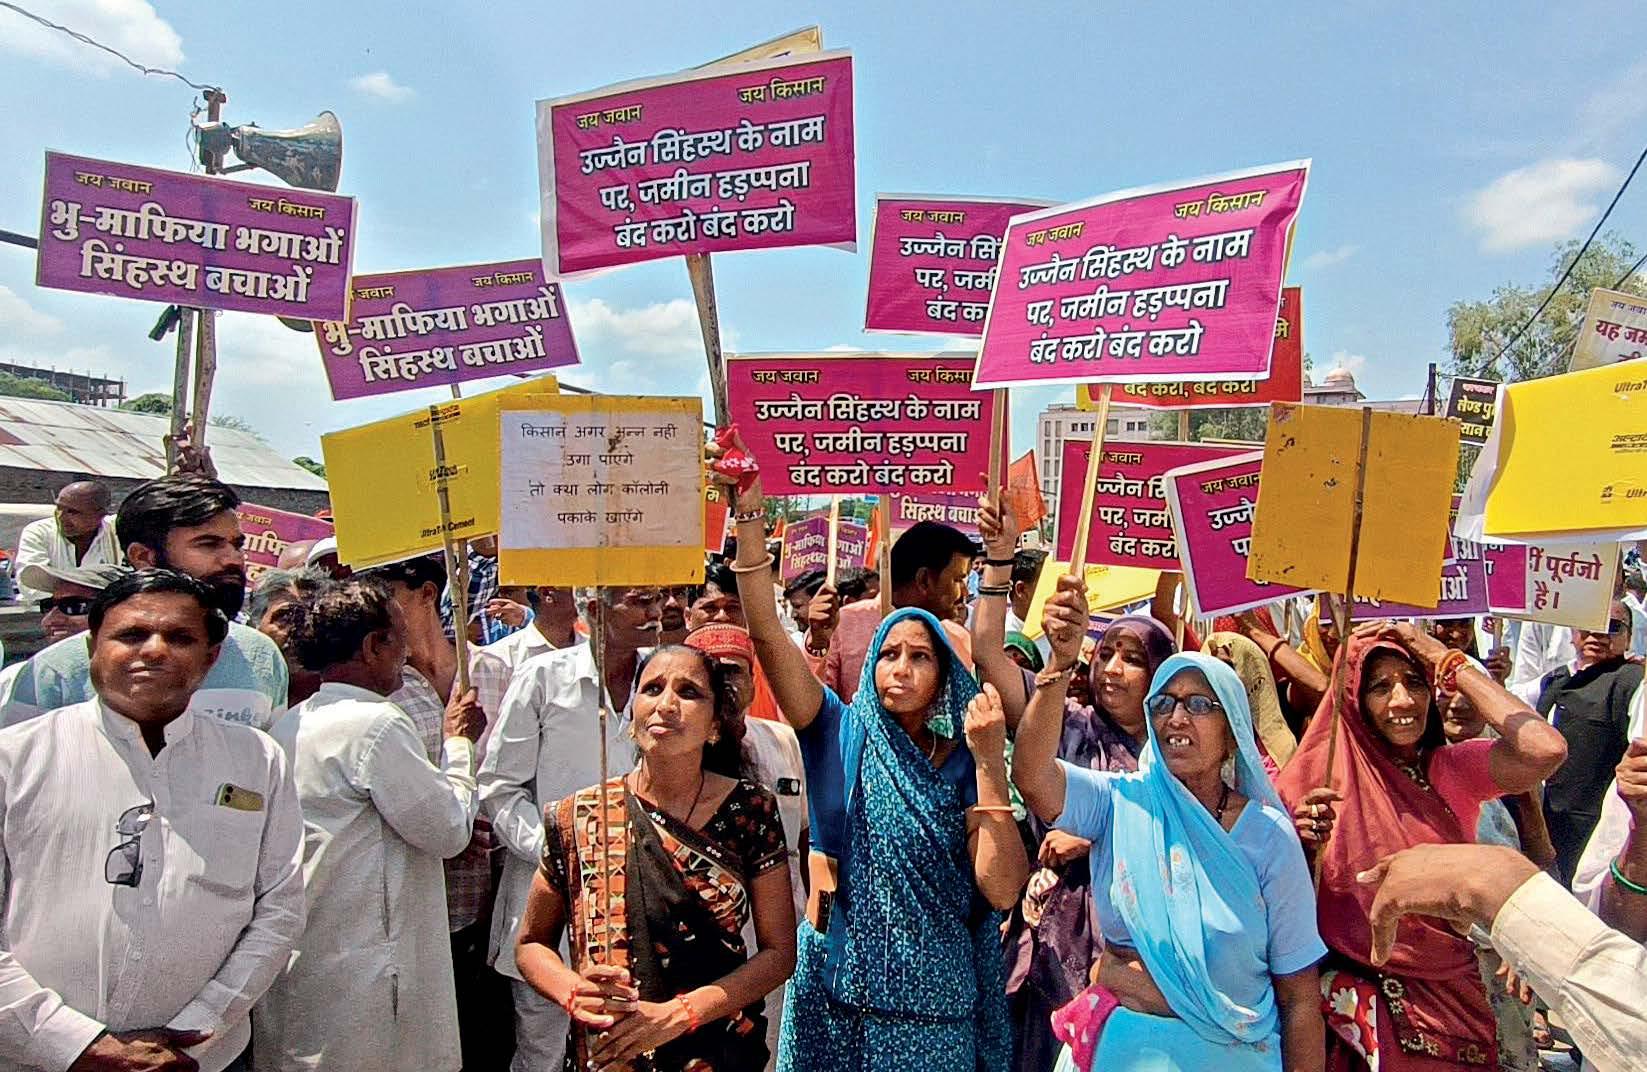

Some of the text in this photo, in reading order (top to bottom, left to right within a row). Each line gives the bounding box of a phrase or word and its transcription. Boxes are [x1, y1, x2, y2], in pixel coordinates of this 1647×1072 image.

[738, 76, 825, 103] जय किसान
[576, 105, 642, 129] जय जवान
[580, 116, 825, 174] उज्जैन सिंहस्थ के नाम
[75, 171, 152, 193] जय जवान
[600, 160, 810, 212] पर, जमीन हड़प्पना
[249, 198, 325, 219] जय किसान
[901, 209, 965, 224] जय जवान
[1175, 189, 1266, 220] जय किसान
[614, 199, 795, 248] बंद करो बंद करो
[1025, 221, 1085, 247] जय जवान
[235, 226, 345, 265] भगाओं
[899, 231, 967, 258] उज्जैन
[80, 239, 313, 302] सिंहस्थ बचाओं
[1018, 228, 1254, 290] उज्जैन सिंहस्थ के नाम
[472, 271, 535, 288] जय किसान
[914, 268, 949, 293] पर,
[357, 287, 394, 300] जवान
[471, 286, 560, 326] भगाओं
[1026, 278, 1231, 329] पर, जमीन हड़प्पना
[926, 295, 959, 320] बंद
[1029, 319, 1204, 364] बंद करो बंद करो
[1596, 320, 1622, 341] यह
[359, 325, 546, 382] सिंहस्थ बचाओं
[753, 368, 820, 383] जय जवान
[907, 365, 974, 383] जय किसा
[755, 391, 981, 421] उज्जैन सिंहस्थ के नाम
[521, 422, 567, 439] किसान
[574, 425, 606, 439] अगर
[615, 425, 647, 440] अन्न
[774, 426, 968, 458] पर, जमीन हड़प्पना
[566, 454, 592, 467] उगा
[1107, 451, 1142, 464] जवान
[789, 458, 954, 486] बंद करो बंद करो
[1096, 472, 1144, 498] ज्जैन
[529, 480, 670, 497] तो क्या लोग कॉलोनी
[1202, 479, 1223, 494] जय
[557, 509, 598, 524] पकाके
[900, 495, 946, 523] सिंहस्थ
[1098, 506, 1129, 529] पर,
[1109, 532, 1137, 555] बंद
[1546, 551, 1603, 583] पूर्वजो
